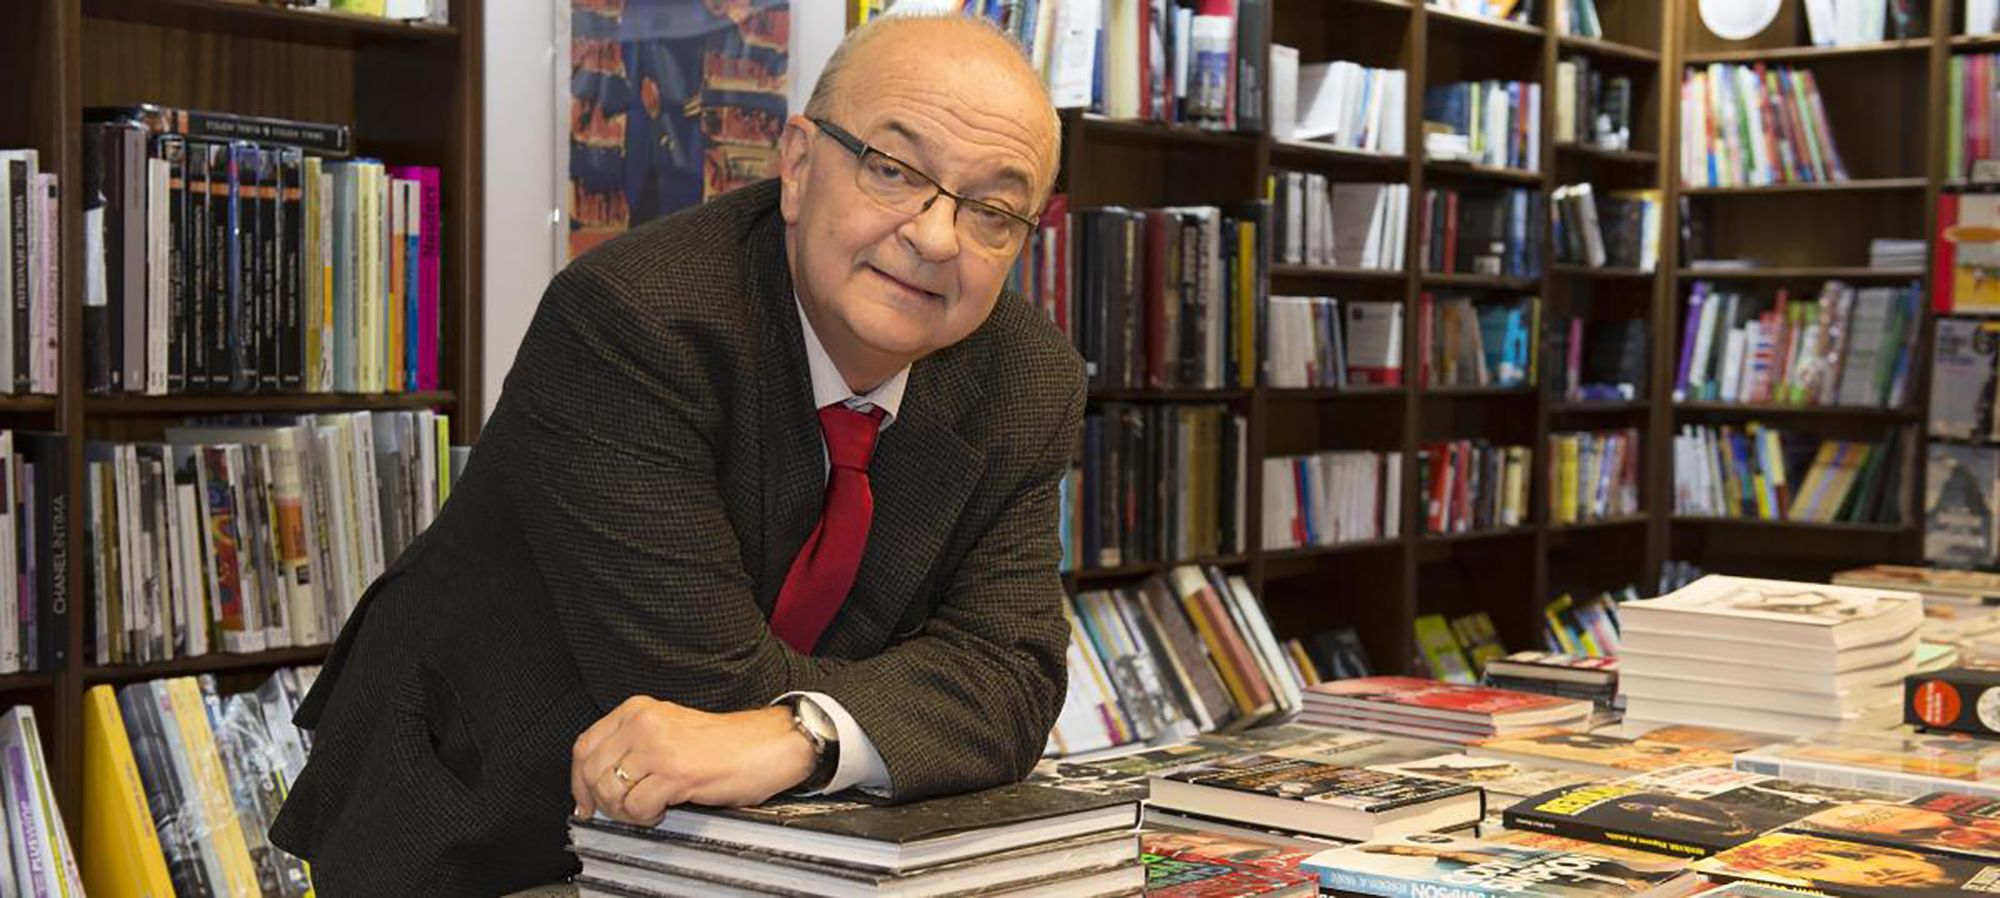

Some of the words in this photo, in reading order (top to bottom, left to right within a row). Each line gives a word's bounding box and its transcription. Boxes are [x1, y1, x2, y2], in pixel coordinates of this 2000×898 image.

[15, 195, 25, 230] MODA
[15, 232, 26, 247] DE
[16, 248, 27, 309] PATRONAJE
